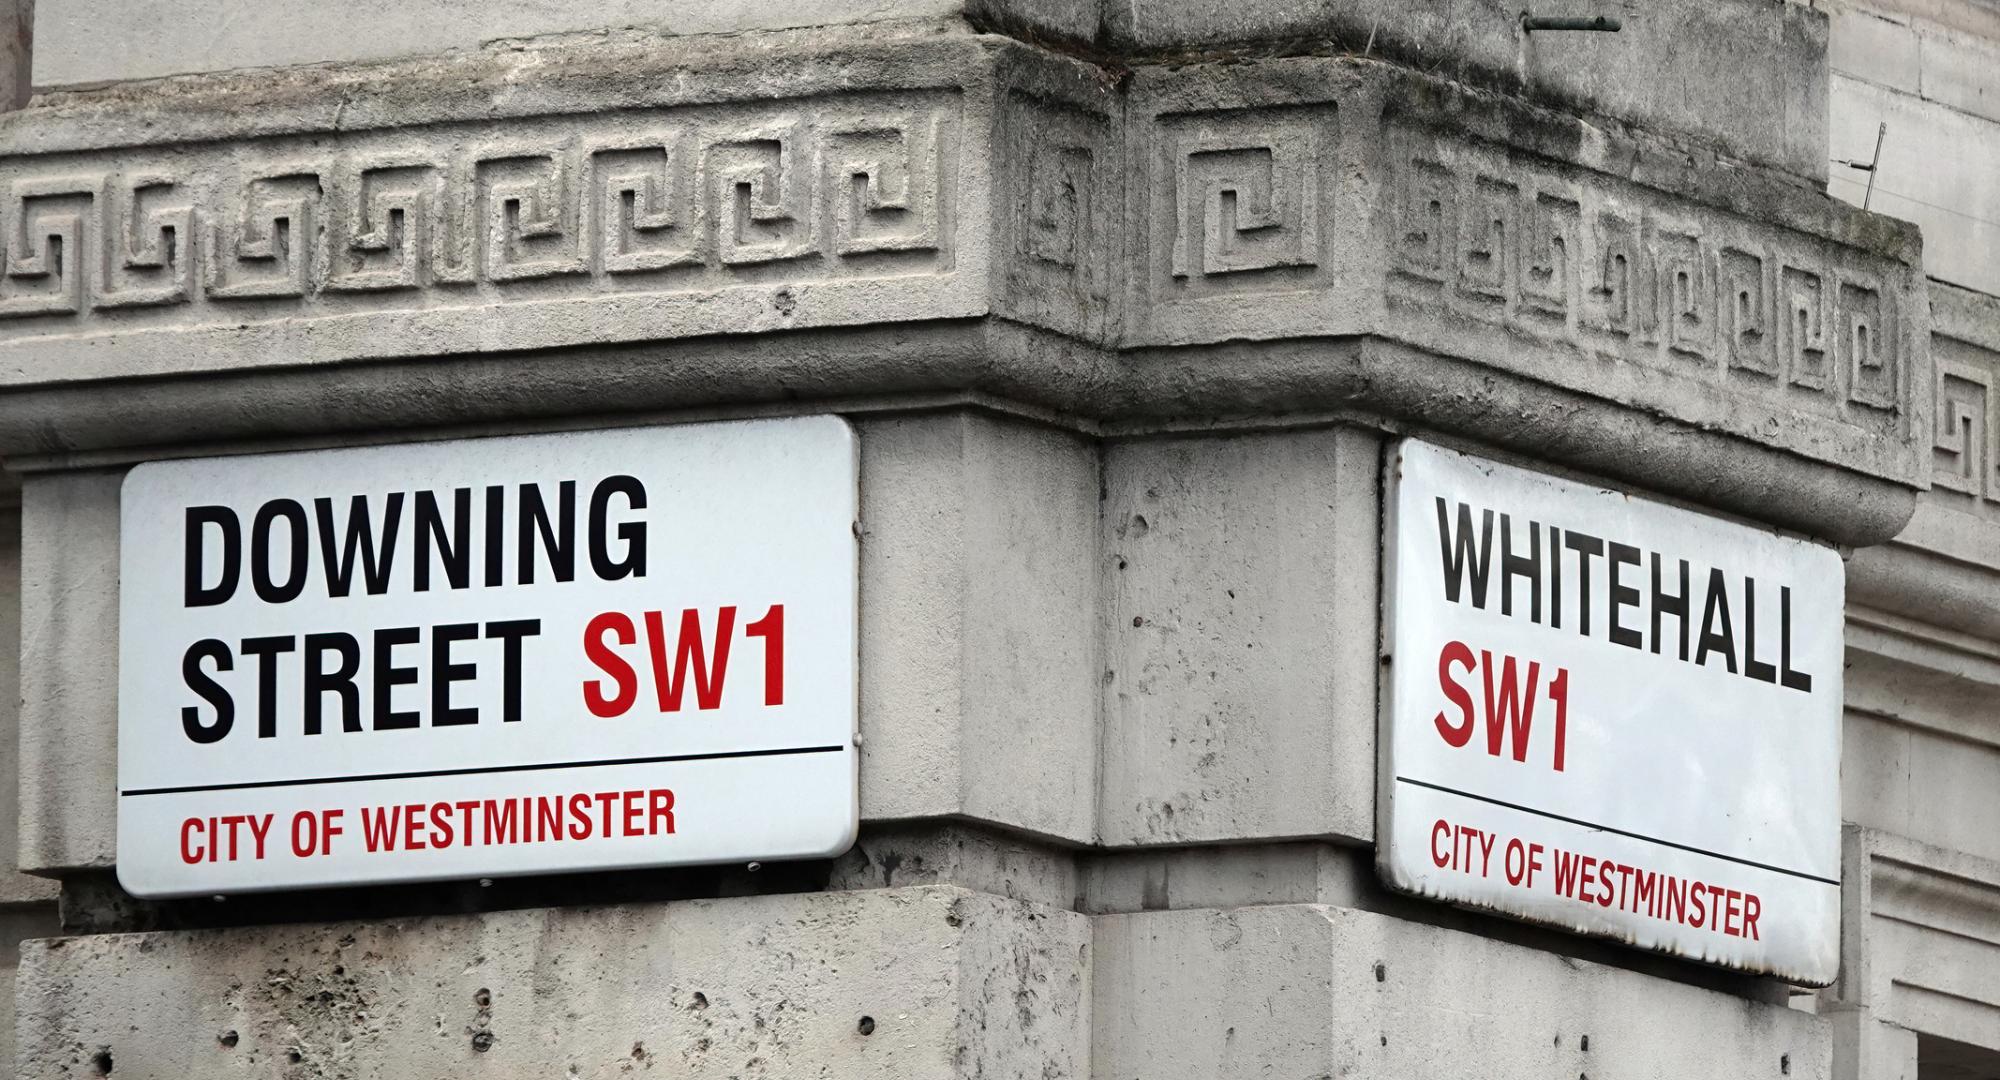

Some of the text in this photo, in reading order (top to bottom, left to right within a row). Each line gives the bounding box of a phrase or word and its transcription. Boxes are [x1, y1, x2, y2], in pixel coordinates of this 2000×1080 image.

[184, 474, 648, 608] DOWNING
[1435, 496, 1812, 693] WHITEHALL
[181, 604, 785, 744] STREET SW1
[1434, 641, 1568, 772] SW1
[180, 788, 675, 865] CITY OF WESTMINSTER
[1431, 819, 1761, 941] CITY OF WESTMINSTER
